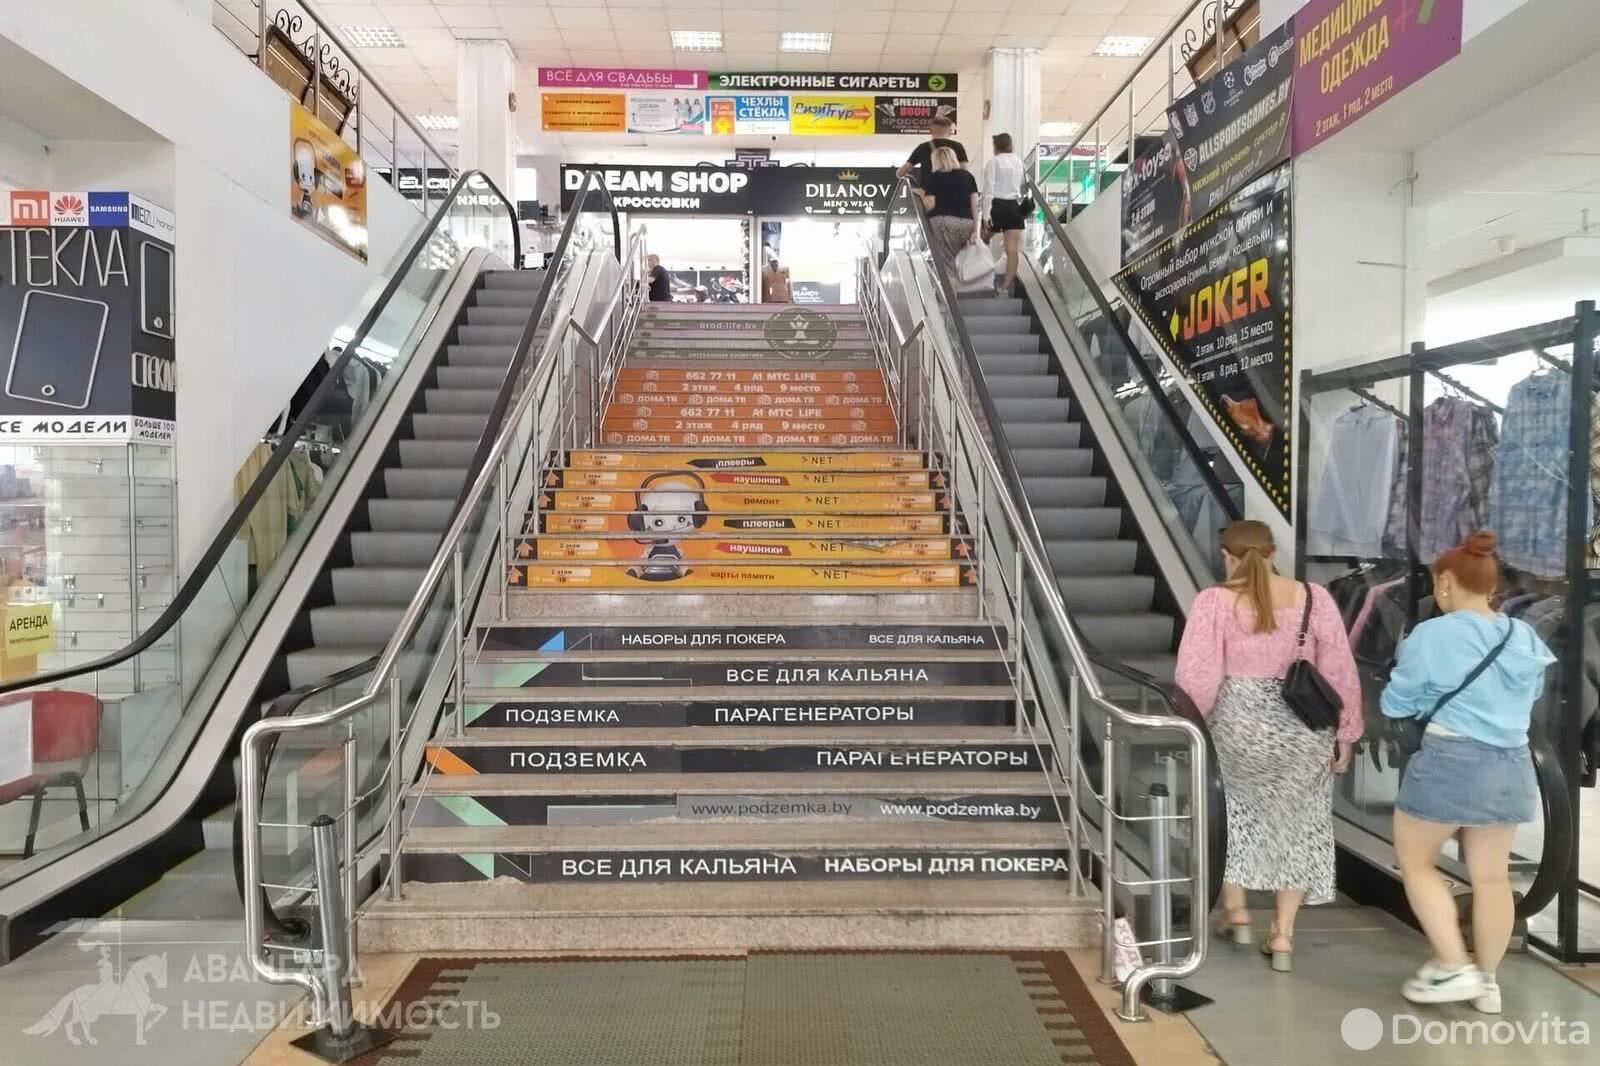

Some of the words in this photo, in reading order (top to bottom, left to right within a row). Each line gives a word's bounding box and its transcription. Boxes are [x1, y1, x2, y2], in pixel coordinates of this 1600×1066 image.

[1320, 15, 1390, 94] ОДЕЖДА
[546, 69, 573, 82] ВСЁ
[576, 71, 604, 82] ДЛЯ
[607, 71, 673, 84] СВАДЬБЫ
[719, 75, 835, 88] ЭЛЕКТРОННЫЕ
[839, 76, 920, 89] СИГАРЕТЫ
[742, 97, 783, 107] ЧЕХЛЫ
[1315, 120, 1321, 137] 2
[1364, 87, 1370, 105] 2
[1371, 75, 1393, 101] МЕСТО
[1200, 74, 1293, 162] ALLSPORTSGAMES.BY
[670, 171, 748, 194] SHOP
[805, 183, 891, 198] DILANOV
[613, 196, 700, 209] КРОССОВКИ
[89, 205, 128, 213] SAMSUNG
[1140, 258, 1175, 291] Огромный
[1175, 246, 1199, 272] выбор
[1200, 220, 1234, 257] мужской
[1235, 205, 1264, 233] обуви
[1184, 257, 1271, 340] JOKER
[1216, 336, 1225, 349] 10
[1225, 333, 1238, 348] ряд
[1240, 326, 1249, 341] 15
[1250, 320, 1273, 337] место
[1219, 364, 1225, 377] 8
[1225, 362, 1238, 378] ряд
[1240, 356, 1249, 371] 12
[1250, 351, 1273, 367] место
[709, 372, 722, 380] 77
[726, 372, 736, 380] 11
[766, 372, 791, 380] МТС
[794, 372, 817, 380] LIFE
[682, 383, 689, 392] 2
[734, 383, 741, 392] 4
[743, 385, 764, 393] ряд
[780, 383, 787, 392] 9
[680, 408, 702, 417] 662
[706, 408, 721, 417] 77
[724, 408, 735, 417] 11
[768, 408, 793, 417] МТС
[799, 408, 822, 417] LIFE
[33, 420, 127, 433] МОДЕЛИ
[134, 418, 161, 430] БОЛЬШЕ
[163, 421, 176, 432] 100
[675, 420, 683, 429] 2
[686, 422, 713, 430] этаж
[731, 420, 739, 429] 4
[742, 422, 764, 432] ряд
[781, 420, 789, 430] 9
[792, 422, 825, 430] место
[626, 435, 655, 443] ДОМА
[701, 435, 733, 443] ДОМА
[775, 435, 805, 443] ДОМА
[850, 435, 879, 443] ДОМА
[718, 457, 755, 467] плееры
[811, 456, 833, 464] NET
[733, 475, 781, 485] наушники
[813, 475, 835, 483] NET
[744, 497, 779, 507] ремонт
[815, 496, 838, 505] NET
[742, 518, 785, 529] плееры
[817, 519, 841, 528] NET
[729, 543, 783, 555] наушники
[820, 543, 845, 552] NET
[710, 571, 738, 581] карты
[741, 572, 775, 581] памяти
[823, 570, 849, 579] NET
[9, 615, 48, 631] АРЕНДА
[621, 633, 688, 646] НАБОРЫ
[690, 633, 722, 646] ДЛЯ
[726, 632, 786, 645] ПОКЕРА
[869, 635, 894, 644] ВСЕ
[897, 635, 924, 645] ДЛЯ
[927, 635, 985, 645] КАЛЬЯНА
[726, 668, 769, 683] ВСЕ
[776, 668, 820, 685] ДЛЯ
[828, 668, 929, 683] КАЛЬЯНА
[505, 708, 621, 725] ПОДЗЕМКА
[714, 706, 914, 723] ПАРАГЕНЕРАТОРЫ
[510, 751, 648, 771] ПОДЗЕМКА
[691, 800, 852, 817] www.podzemka.by
[880, 802, 1041, 820] www.podzemka.by
[561, 859, 613, 876] ВСЕ
[619, 858, 671, 878] ДЛЯ
[680, 857, 798, 875] КАЛЬЯНА
[823, 857, 923, 873] НАБОРЫ
[928, 857, 974, 875] ДЛЯ
[981, 857, 1069, 872] ПОКЕРА
